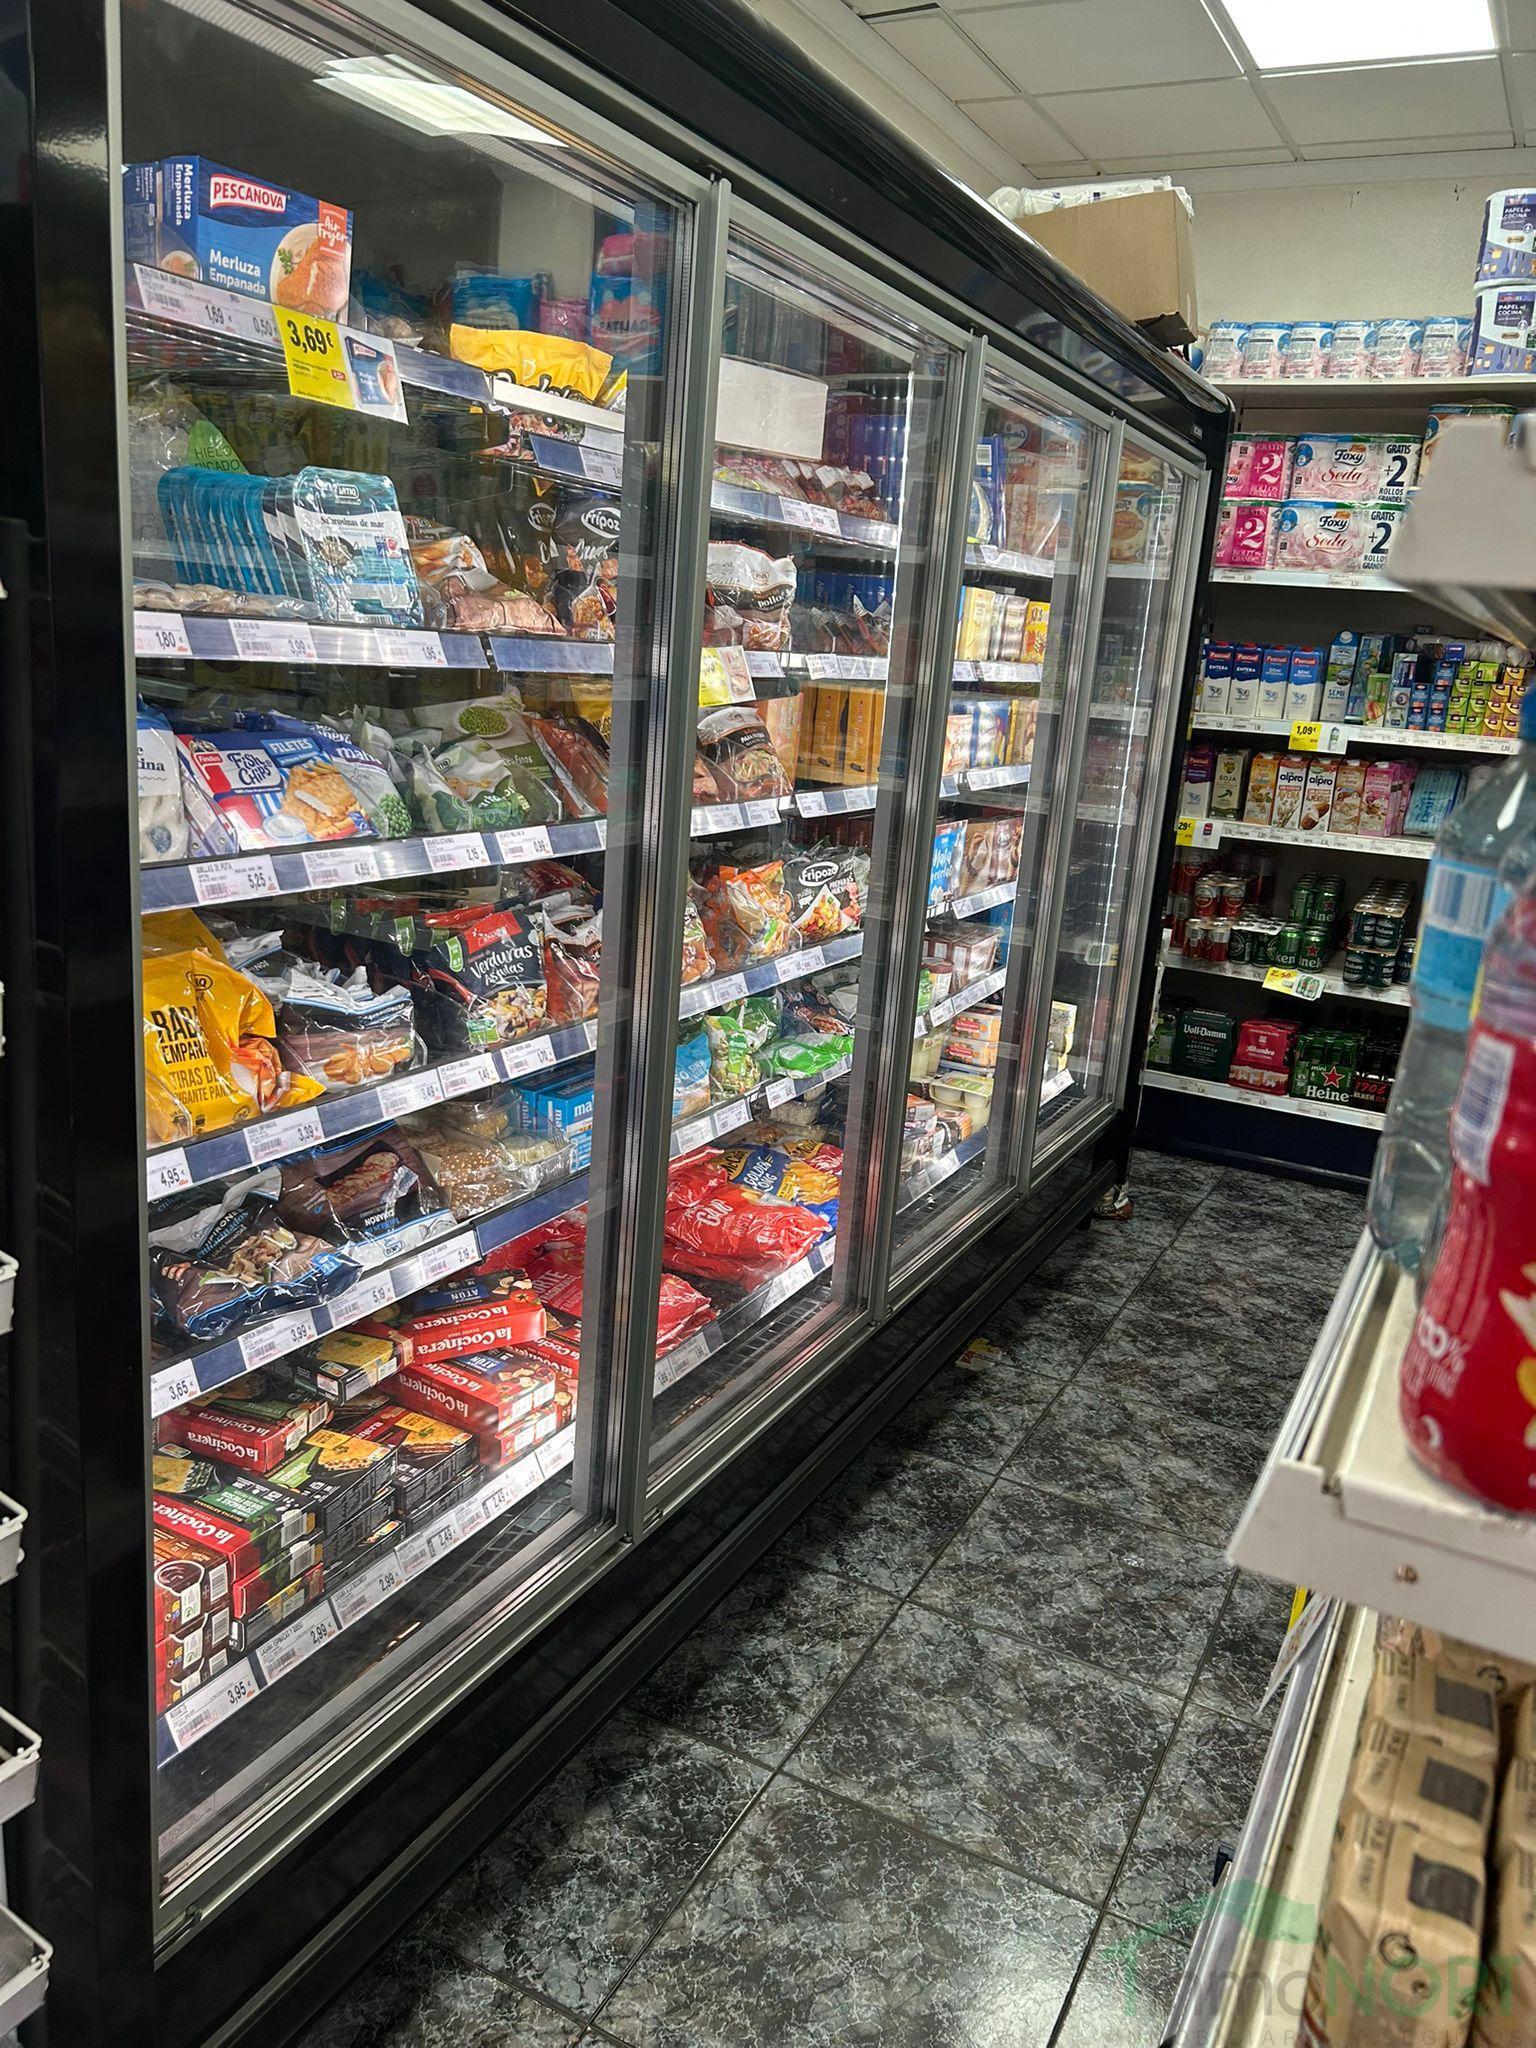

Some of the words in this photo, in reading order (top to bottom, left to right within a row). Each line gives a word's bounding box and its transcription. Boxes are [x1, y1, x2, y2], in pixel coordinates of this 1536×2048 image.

[174, 163, 183, 227] Empanada
[183, 163, 194, 220] Merluza
[213, 181, 284, 210] PESCANOVA
[1503, 212, 1528, 220] COCINA
[325, 217, 341, 232] Air
[317, 225, 350, 248] Fryer
[209, 249, 261, 278] Merluza
[209, 268, 267, 296] Empanada
[253, 316, 273, 337] 0,50
[287, 319, 334, 355] 3,69€
[193, 445, 232, 459] HIELO
[1334, 449, 1365, 464] Foxy
[1386, 444, 1411, 455] GRATIS
[1321, 467, 1362, 483] Seda
[1379, 488, 1404, 496] ROLLOS
[1319, 516, 1350, 531] Foxy
[1371, 511, 1395, 521] GRATIS
[1306, 533, 1348, 549] Seda
[1237, 654, 1259, 662] Pascual
[1266, 656, 1287, 664] Pascual
[1295, 657, 1316, 666] Pascual
[269, 738, 313, 753] FILETES
[1219, 774, 1237, 782] SOJA
[1279, 772, 1304, 785] alpro
[1308, 775, 1333, 787] alpro
[248, 873, 267, 889] 5,25
[801, 863, 838, 884] Fripozo
[470, 944, 534, 979] Verduras
[169, 1069, 201, 1091] TIRAS
[203, 1065, 220, 1085] DE
[1354, 1081, 1386, 1095] 1906
[160, 1168, 180, 1187] 4,95
[743, 1157, 771, 1188] GOLDEN
[450, 1286, 480, 1300] ATÚN
[290, 1325, 308, 1343] 3,99
[168, 1380, 189, 1401] 3,65
[379, 1571, 395, 1593] 2,99
[309, 1623, 327, 1645] 2,99
[227, 1681, 247, 1704] 3,95
